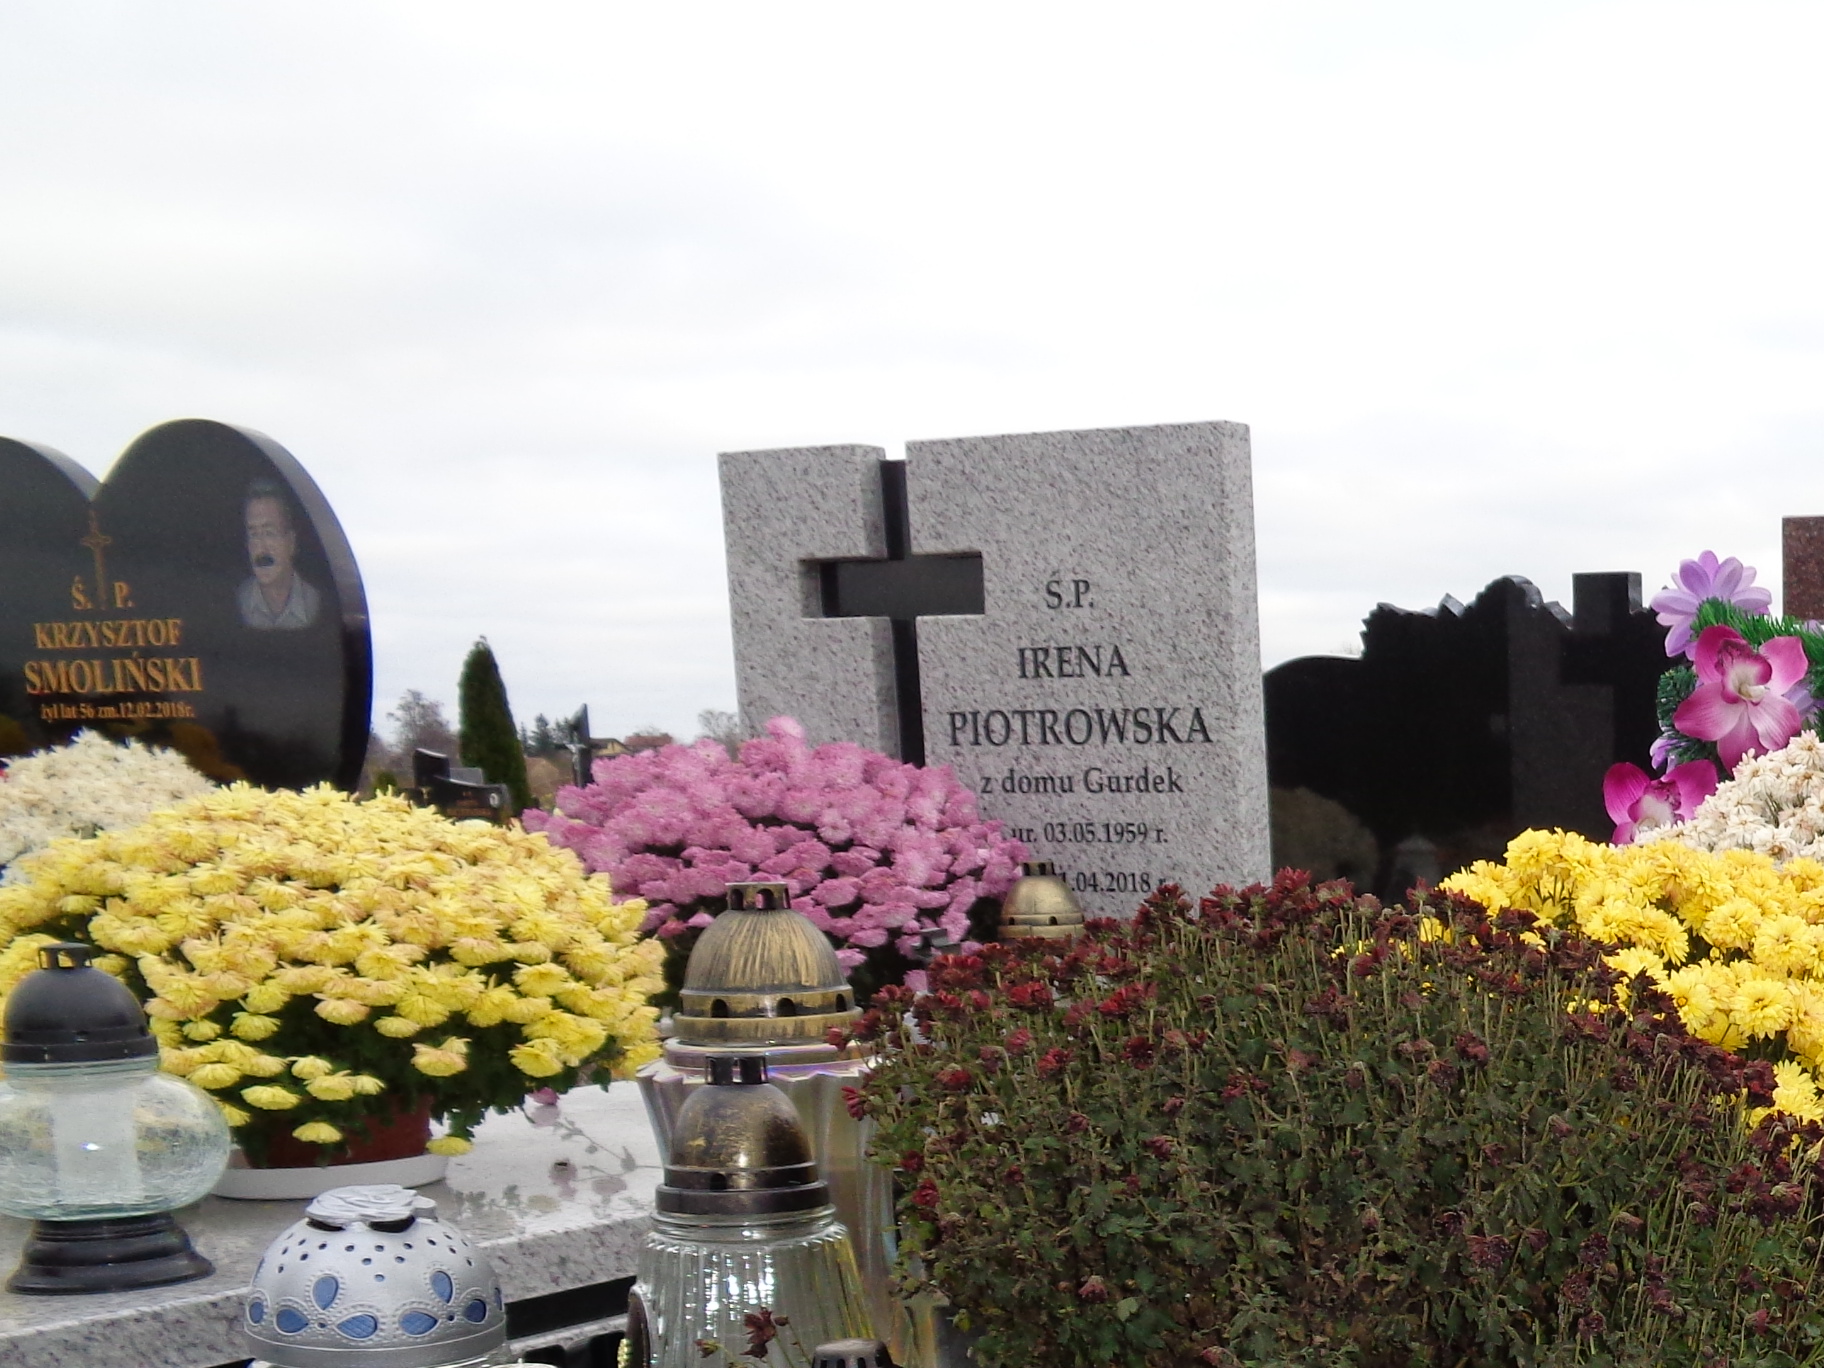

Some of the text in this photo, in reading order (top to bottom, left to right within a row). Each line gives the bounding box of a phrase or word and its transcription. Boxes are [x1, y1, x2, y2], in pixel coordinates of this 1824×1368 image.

[35, 619, 182, 649] KRZYSZTOF
[24, 652, 203, 694] SMOLIŃSKI
[1017, 644, 1132, 679] IRENA
[948, 706, 1214, 747] PIOTROWSKA
[981, 766, 1185, 795] z domu Gurdek
[1043, 821, 1149, 845] 03.05.1959
